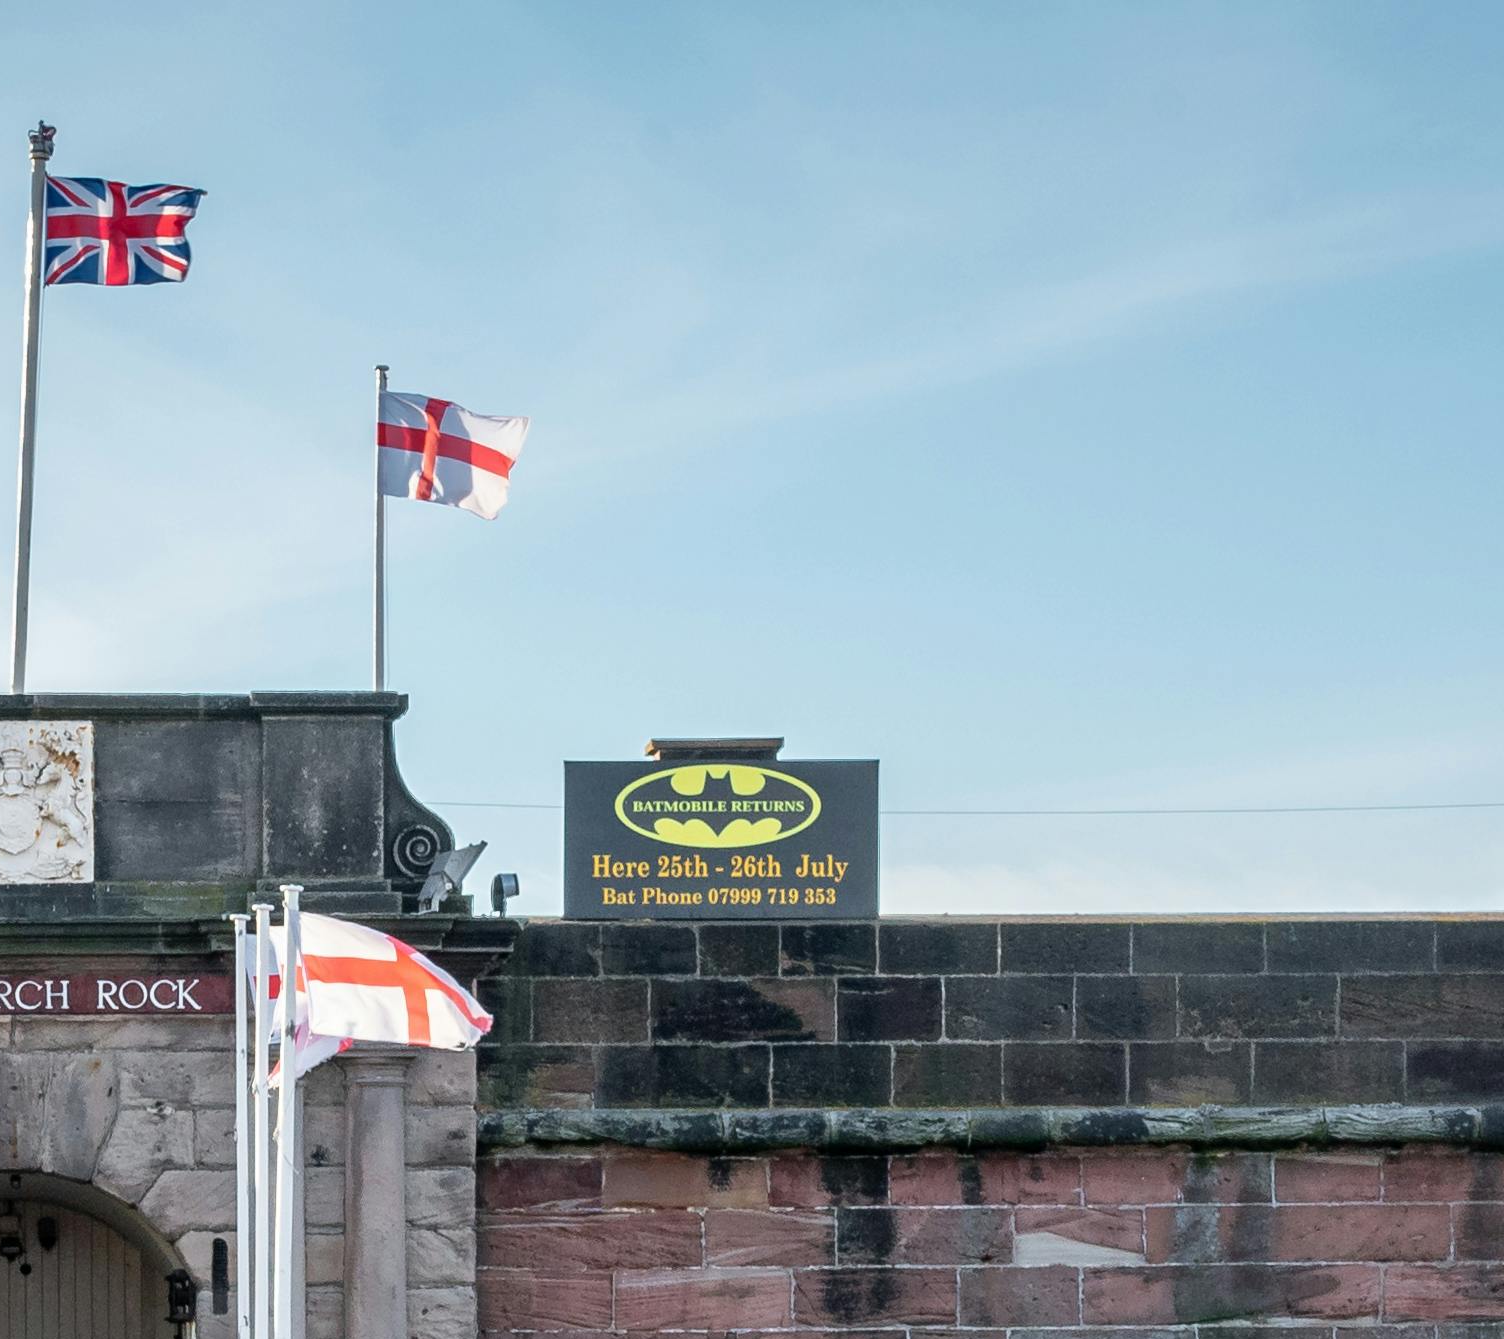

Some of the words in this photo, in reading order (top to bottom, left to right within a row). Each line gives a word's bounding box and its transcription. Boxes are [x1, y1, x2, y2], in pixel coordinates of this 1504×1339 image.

[632, 800, 727, 813] BATMOBILE
[731, 800, 805, 813] RETURNS
[592, 854, 651, 879] Here
[657, 854, 709, 879] 25th
[730, 854, 782, 879] 26th
[795, 853, 849, 883] July
[602, 887, 636, 906] Bat
[641, 887, 703, 905] Phone
[707, 887, 763, 905] 07999
[767, 887, 800, 905] 719
[804, 887, 837, 905] 353
[96, 979, 202, 1011] ROCK
